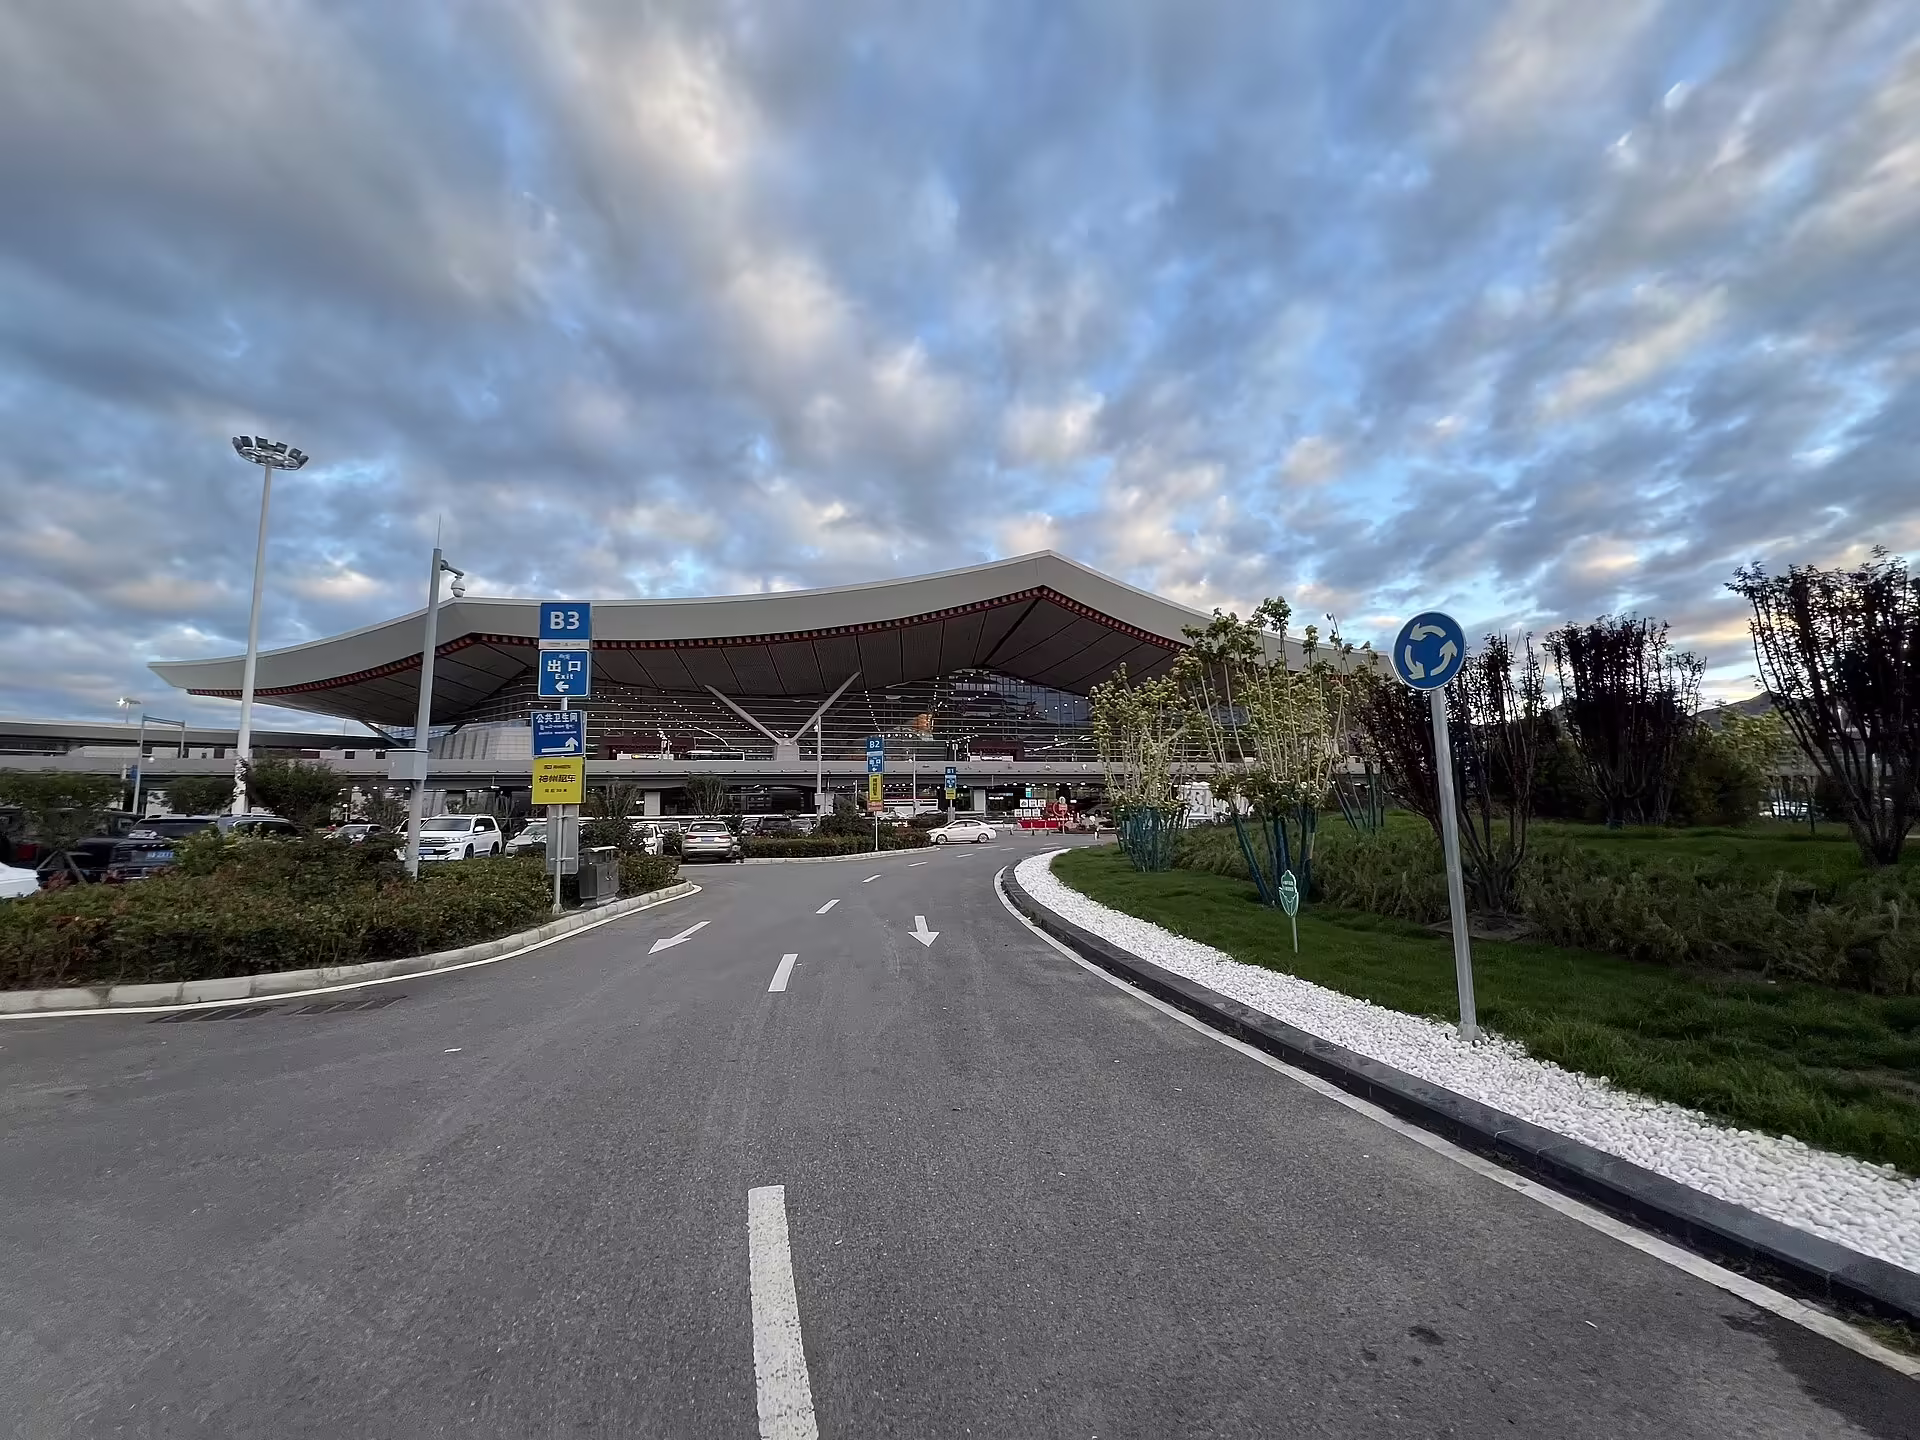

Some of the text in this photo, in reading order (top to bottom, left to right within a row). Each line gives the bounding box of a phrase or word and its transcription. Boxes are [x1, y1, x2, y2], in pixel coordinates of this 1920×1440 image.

[550, 611, 580, 630] B3
[547, 659, 582, 672] 出口
[536, 712, 578, 723] 公共卫生间
[869, 740, 880, 748] B2
